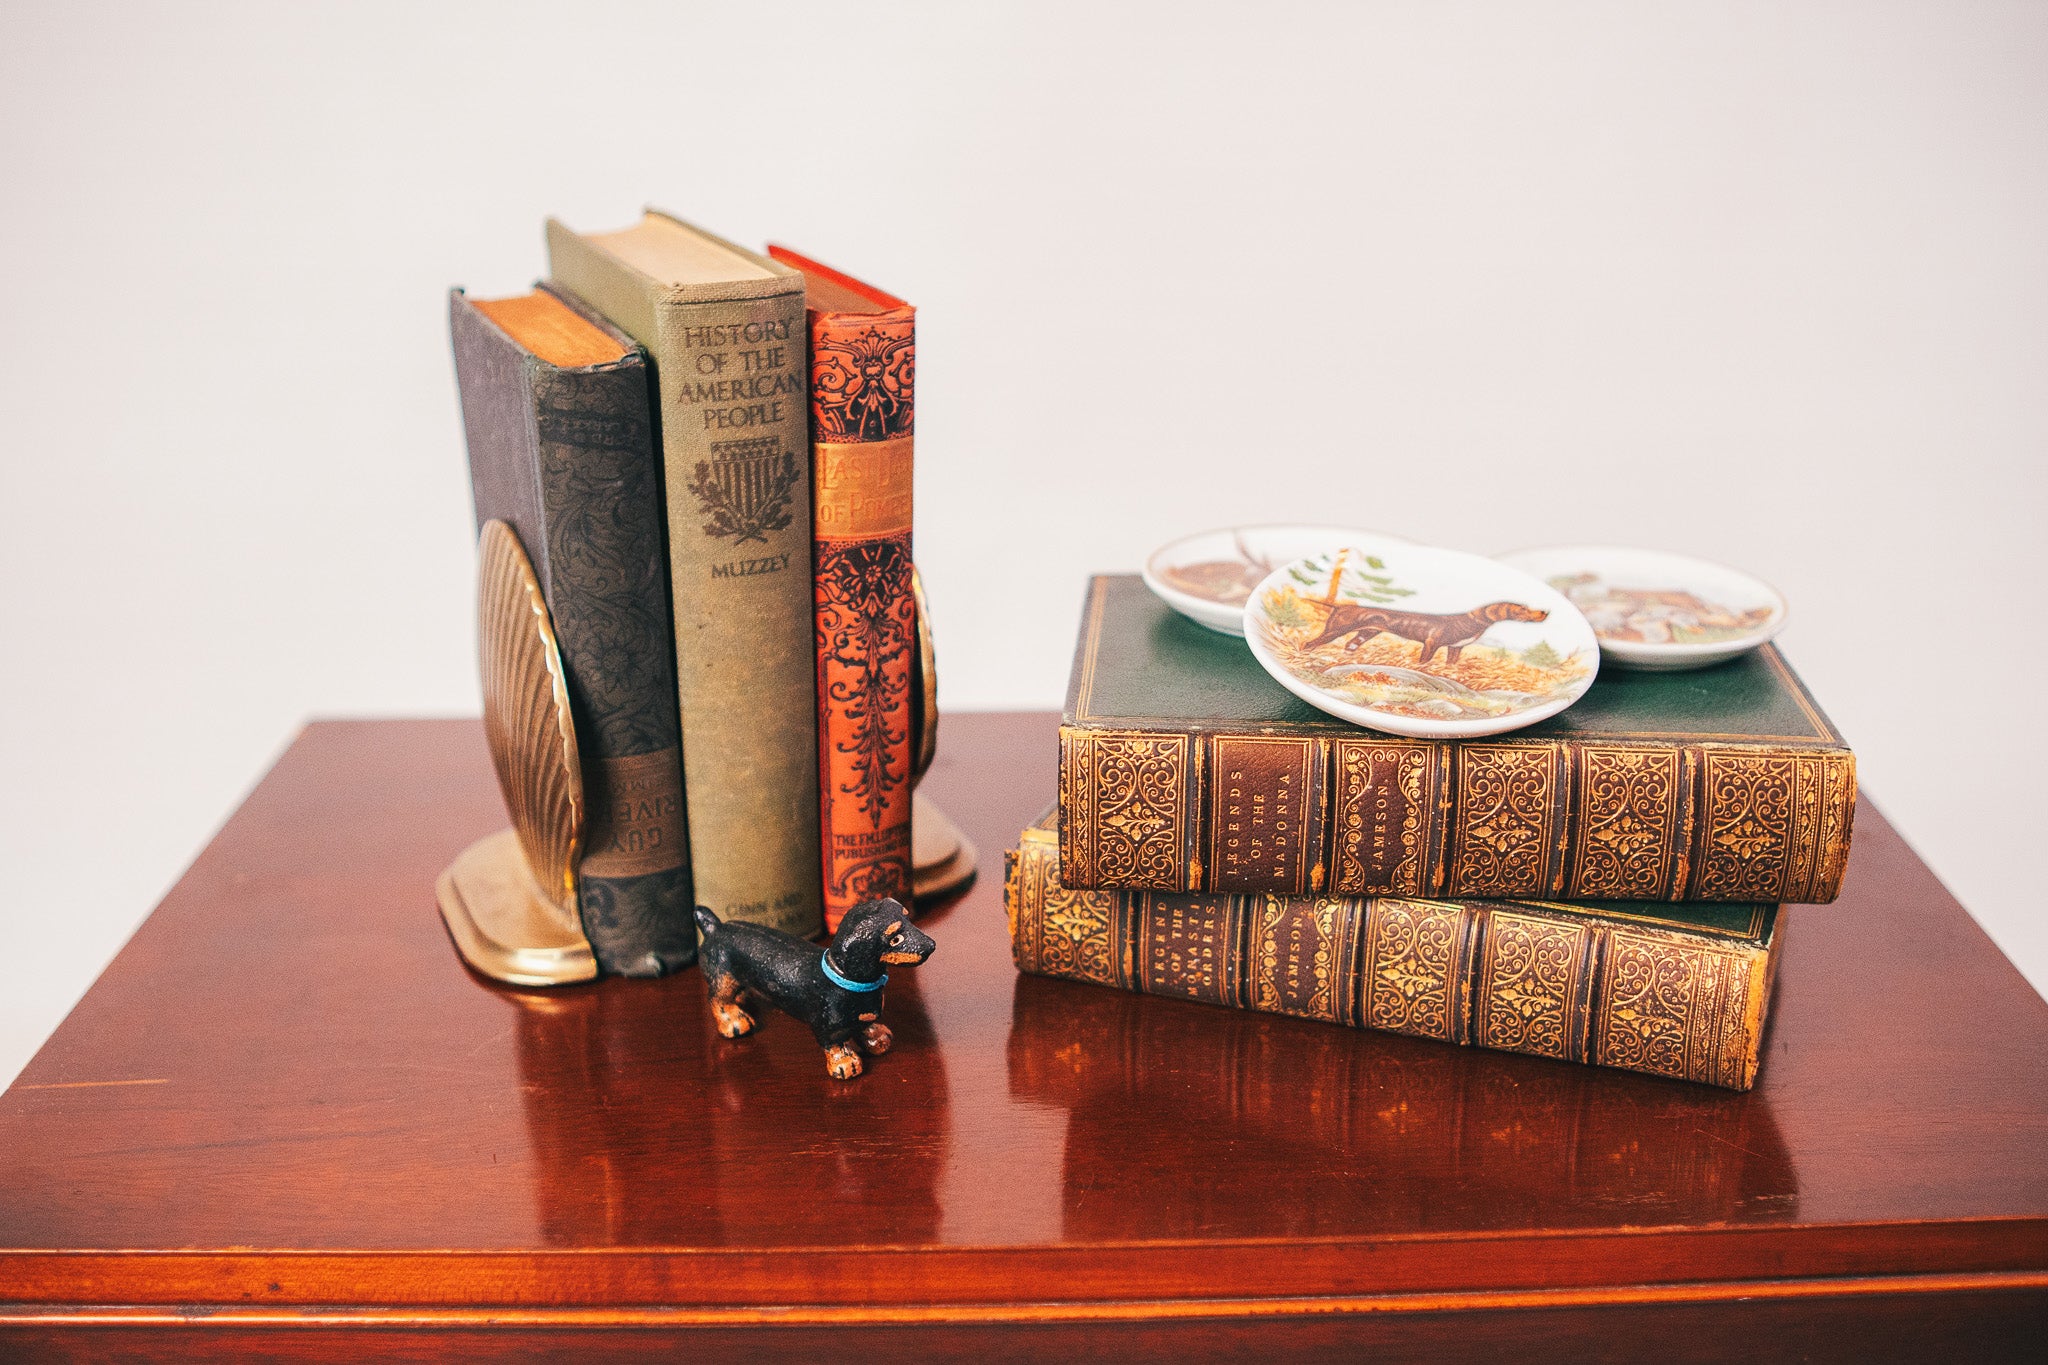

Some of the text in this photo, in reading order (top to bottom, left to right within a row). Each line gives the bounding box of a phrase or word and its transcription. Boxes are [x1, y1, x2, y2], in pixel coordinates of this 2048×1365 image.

[684, 318, 795, 348] HISTORY
[696, 347, 786, 375] OF THE
[677, 374, 801, 405] AMERICAN
[703, 402, 785, 430] PEOPLE
[711, 553, 791, 579] MUZZEY
[1226, 771, 1242, 876] LEGENDS
[1251, 794, 1265, 860] OF THE
[835, 834, 856, 846] THE
[1154, 901, 1167, 985] LEGEND
[1170, 908, 1184, 973] OF THE
[1187, 904, 1200, 997] MONASTI
